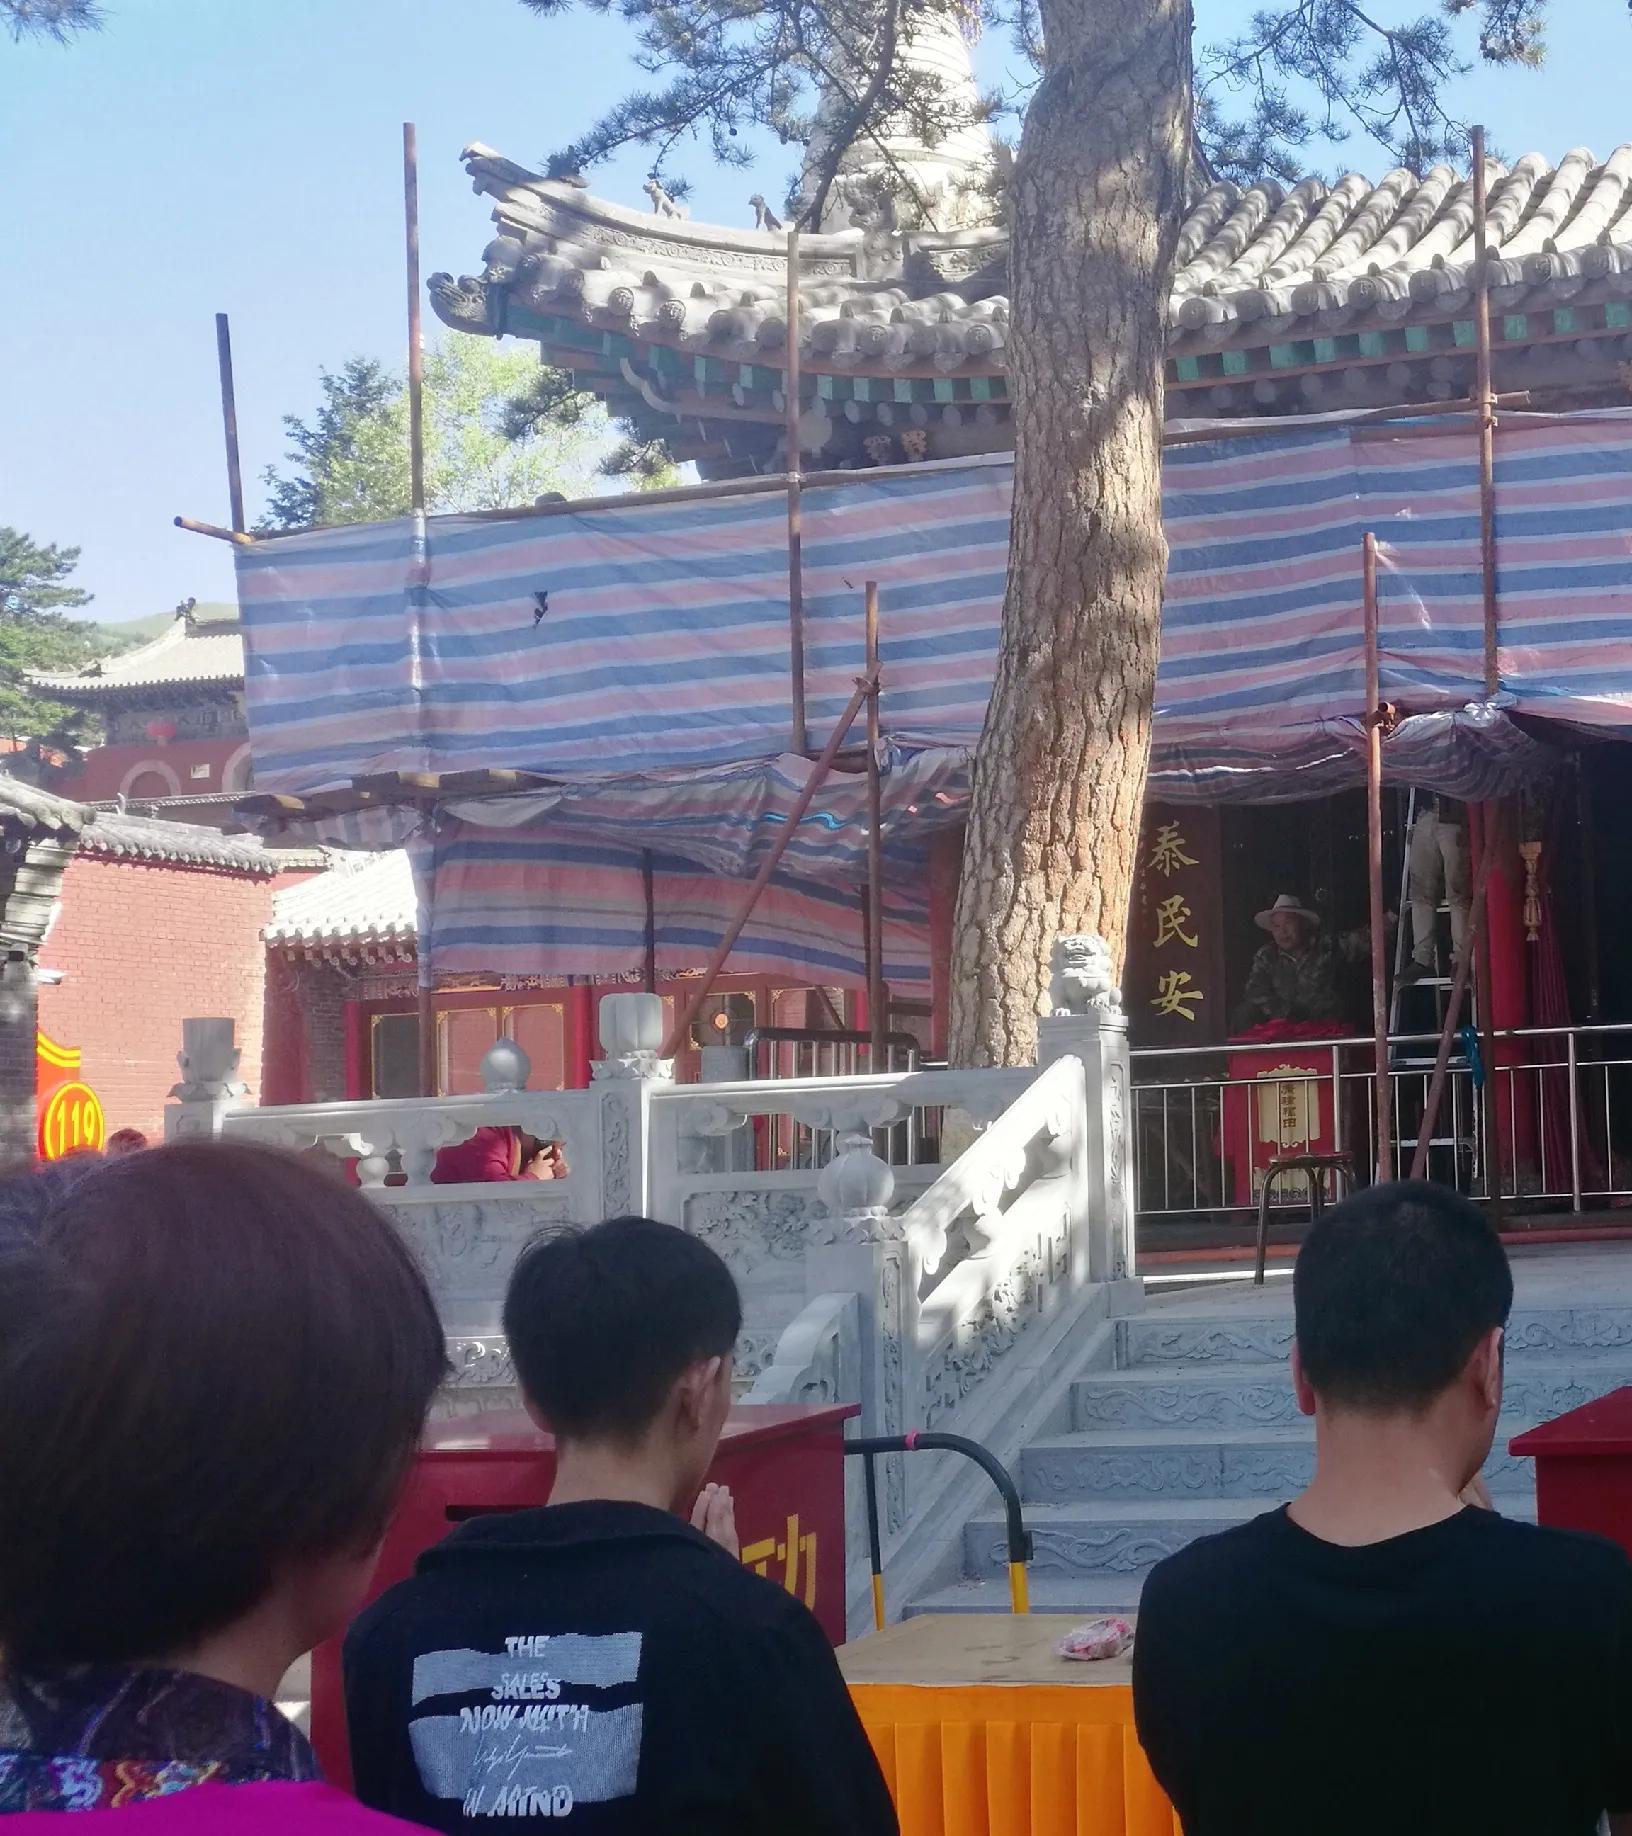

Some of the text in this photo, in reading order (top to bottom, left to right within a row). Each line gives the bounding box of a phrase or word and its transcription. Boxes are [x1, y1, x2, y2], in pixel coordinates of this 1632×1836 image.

[1148, 820, 1204, 1021] 泰民安
[56, 1100, 95, 1156] 119
[505, 1635, 551, 1658] THE
[491, 1671, 561, 1699] SALES
[459, 1705, 519, 1734] NOW
[486, 1784, 574, 1817] MIND
